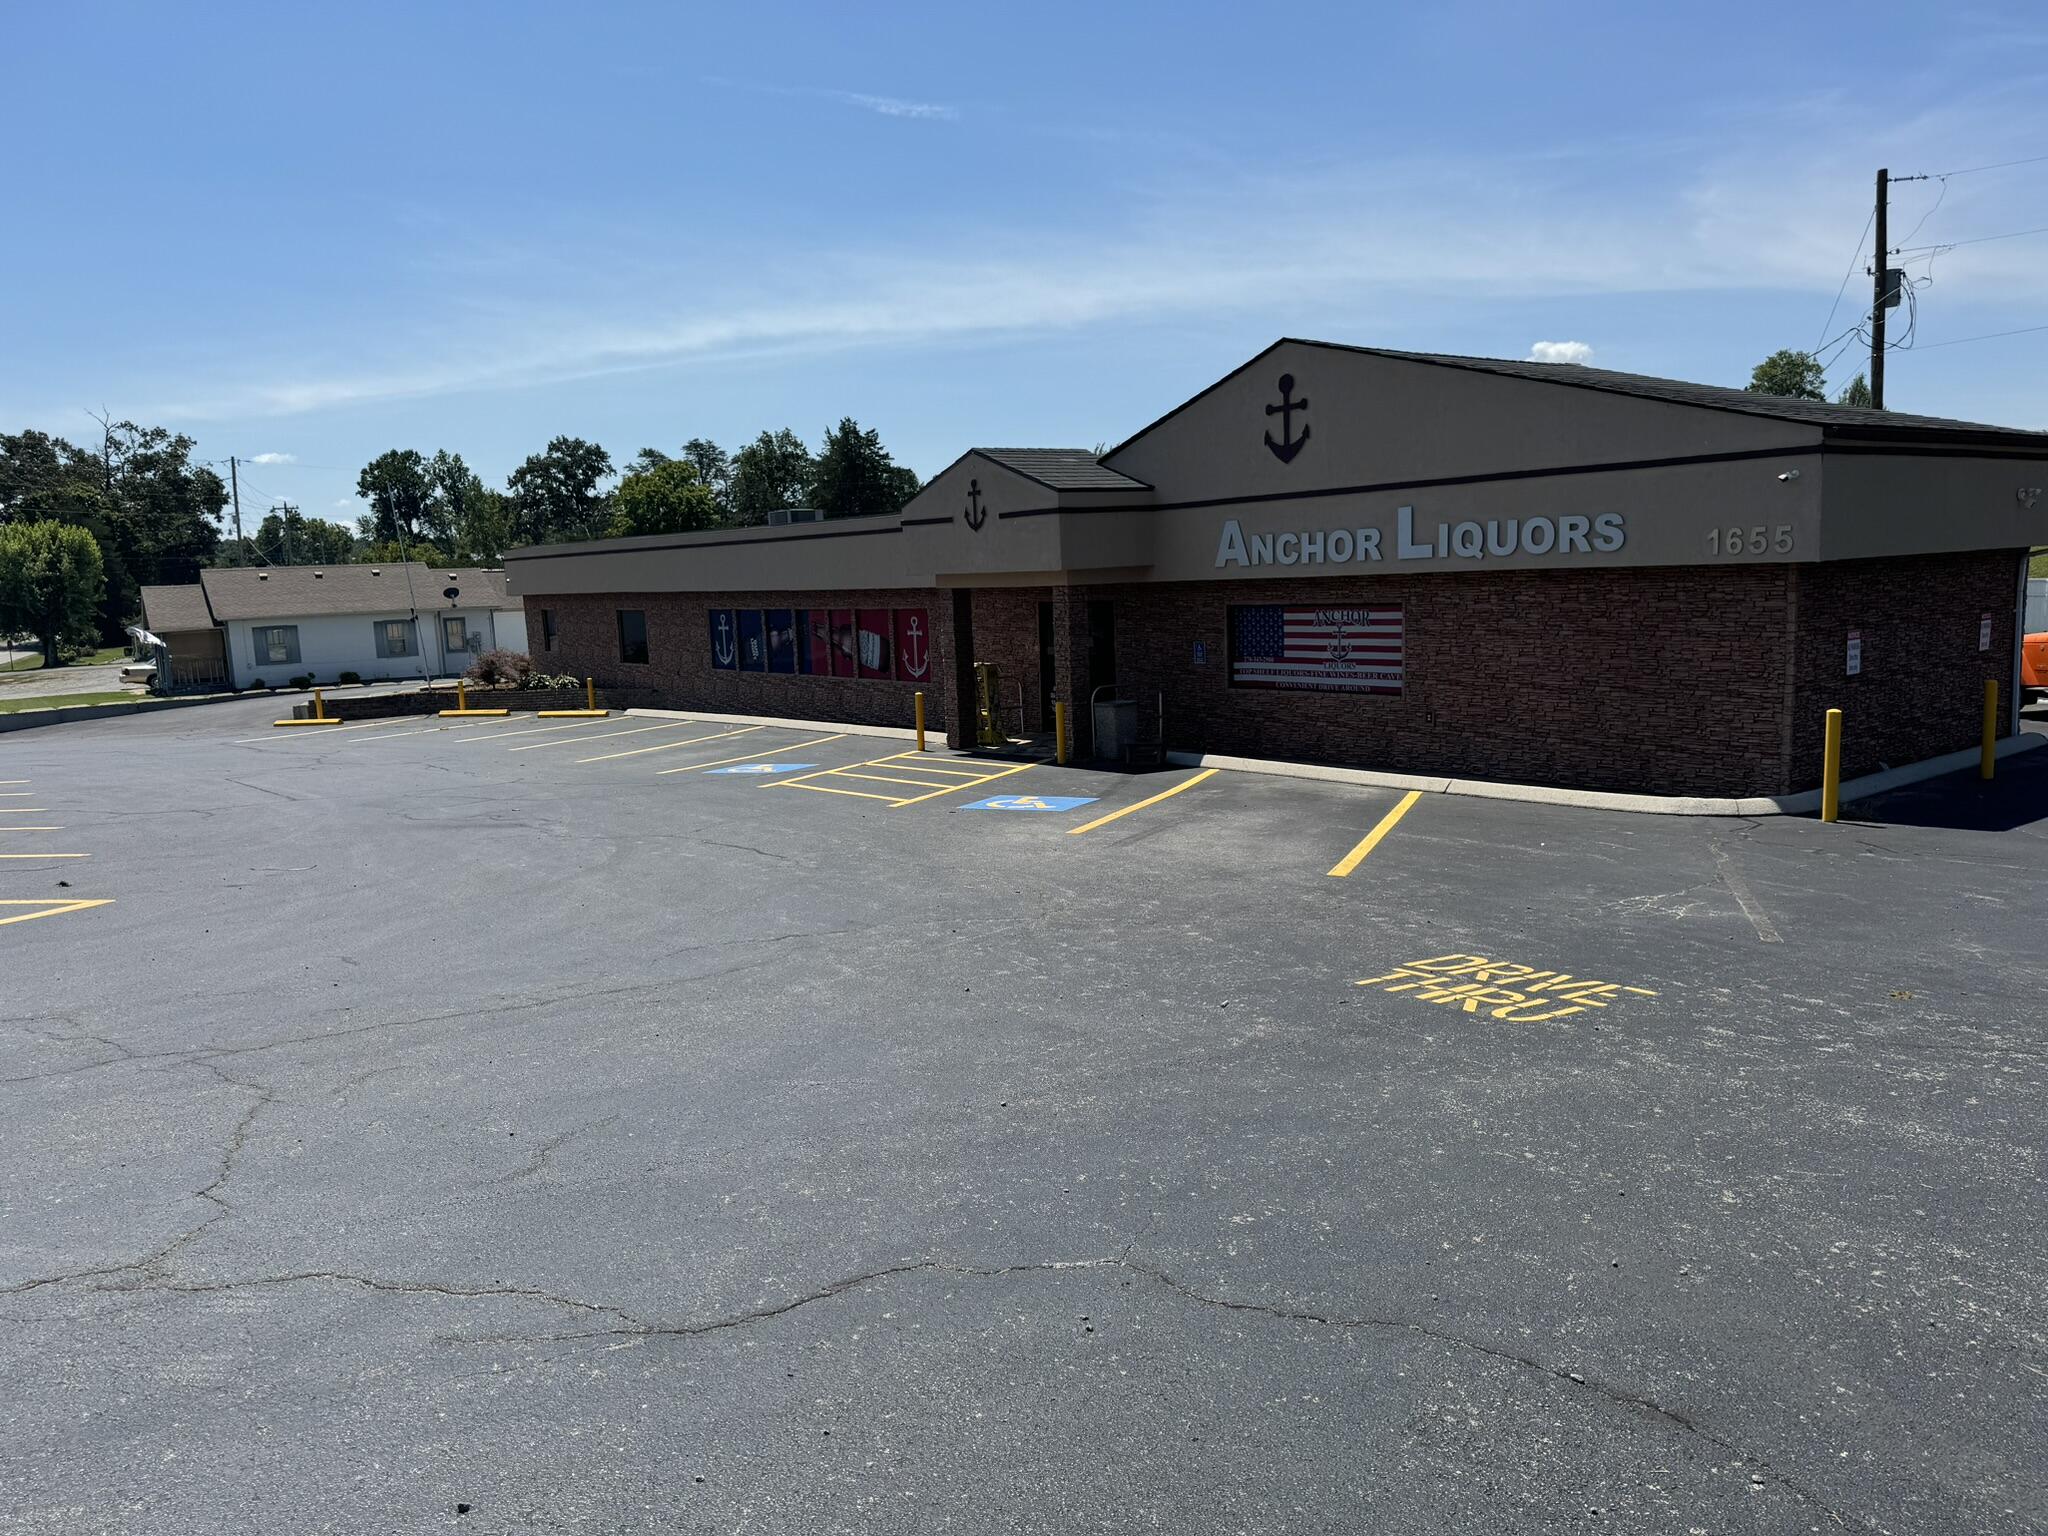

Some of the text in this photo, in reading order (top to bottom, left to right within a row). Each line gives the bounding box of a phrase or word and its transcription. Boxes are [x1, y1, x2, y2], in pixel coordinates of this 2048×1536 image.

[1215, 505, 1625, 568] ANCHOR LIQUORS
[1707, 524, 1794, 556] 1655
[1312, 608, 1370, 627] ANCHOR
[1322, 661, 1356, 670] LIQUORS
[1354, 967, 1586, 1022] THRU
[1403, 953, 1659, 1008] DRIVE
